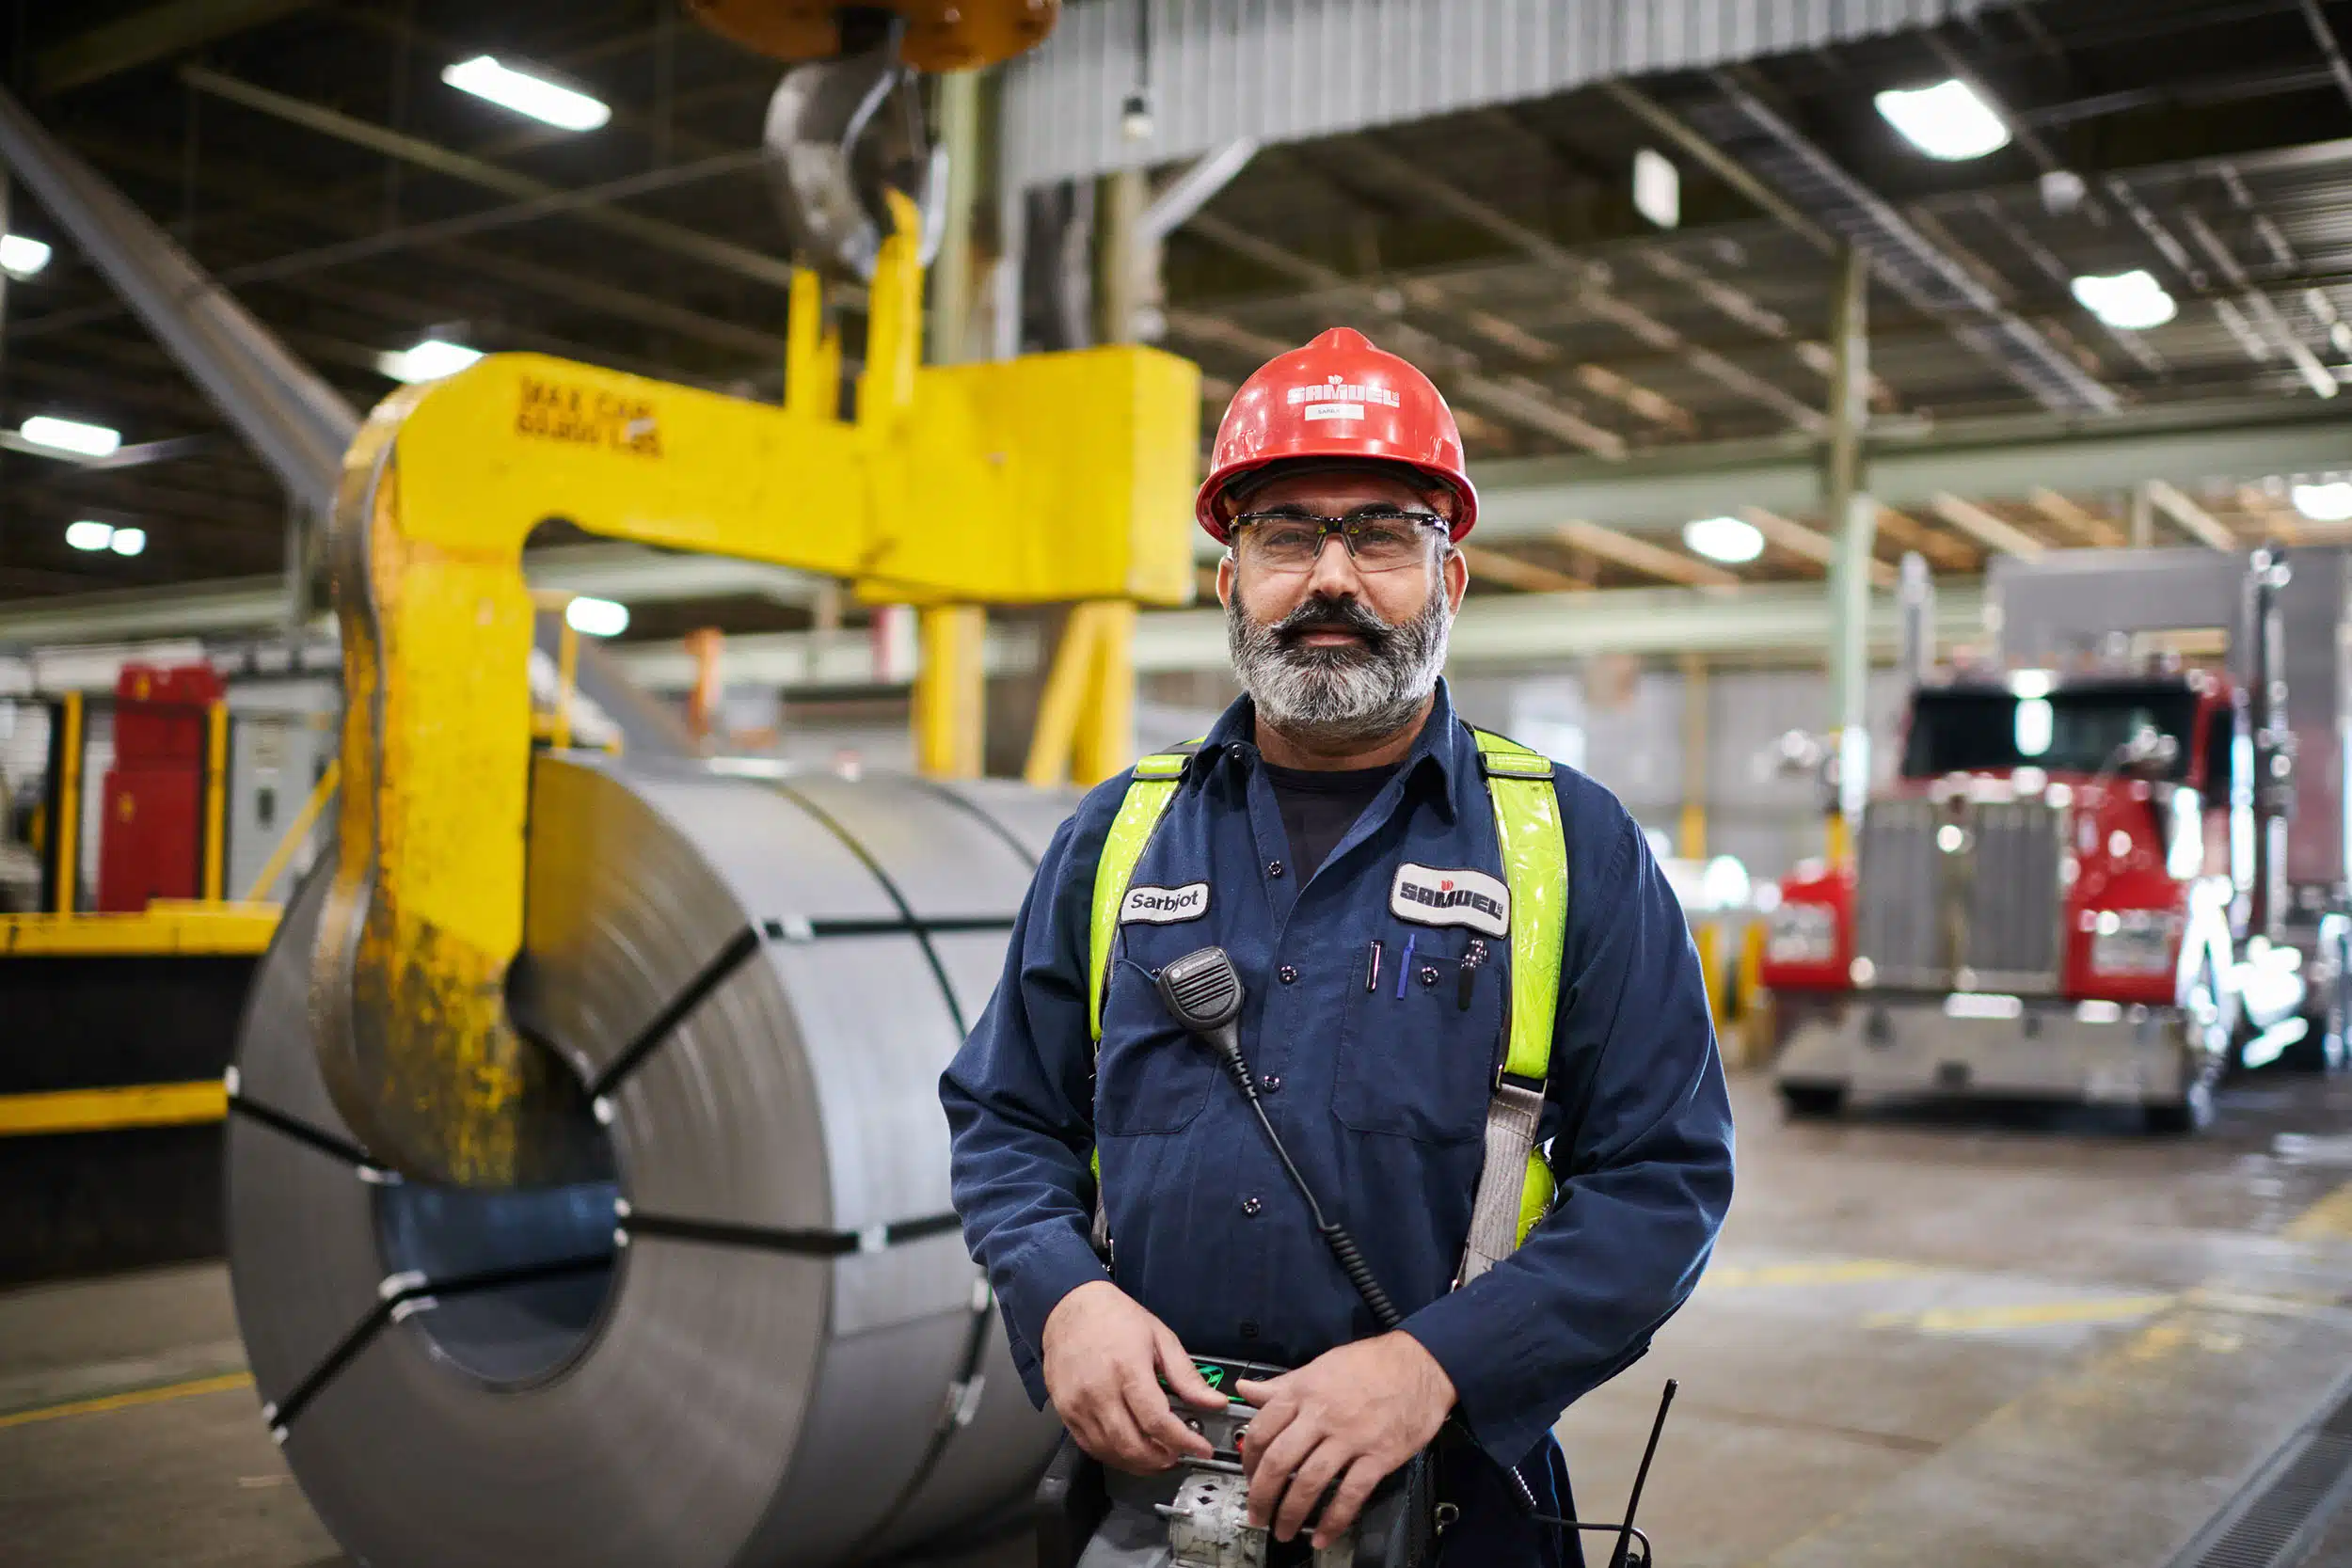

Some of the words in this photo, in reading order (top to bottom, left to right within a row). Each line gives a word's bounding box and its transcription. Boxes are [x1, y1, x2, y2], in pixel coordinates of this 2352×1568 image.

[1287, 384, 1401, 408] SAMUEL
[1131, 890, 1199, 912] Sarbjot
[1399, 880, 1502, 921] SAMUEL
